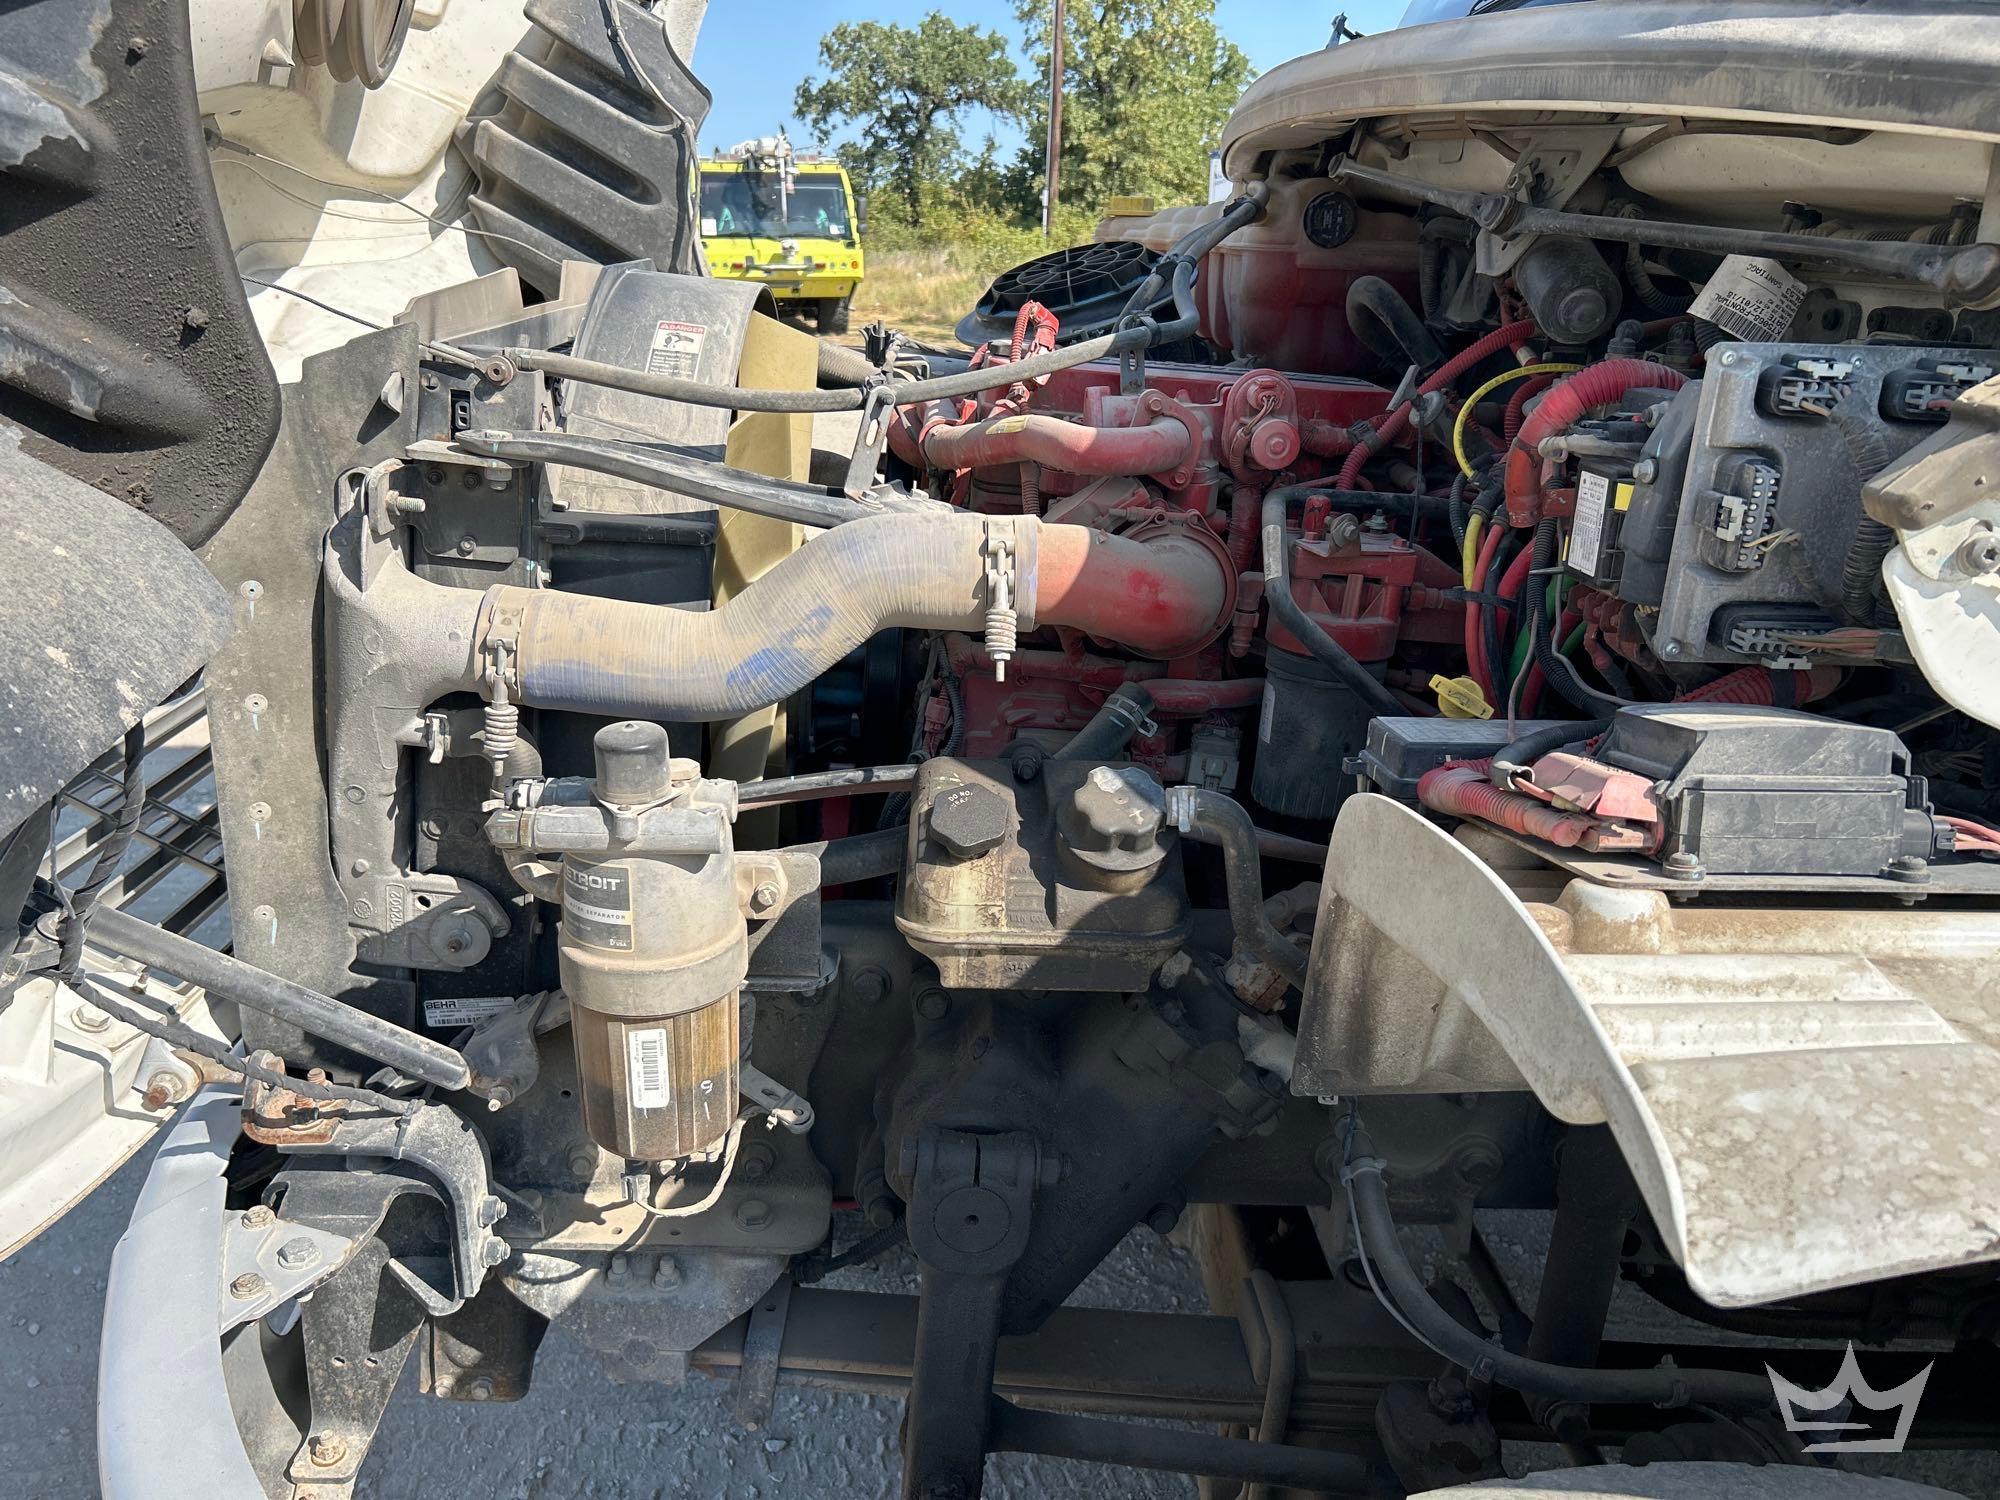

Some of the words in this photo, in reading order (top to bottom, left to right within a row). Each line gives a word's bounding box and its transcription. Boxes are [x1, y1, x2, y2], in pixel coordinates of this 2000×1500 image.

[669, 324, 704, 333] DANGER
[948, 793, 958, 802] DO
[566, 868, 621, 891] ETROIT
[586, 909, 625, 920] SEPARATOR
[426, 1001, 456, 1009] BEHR
